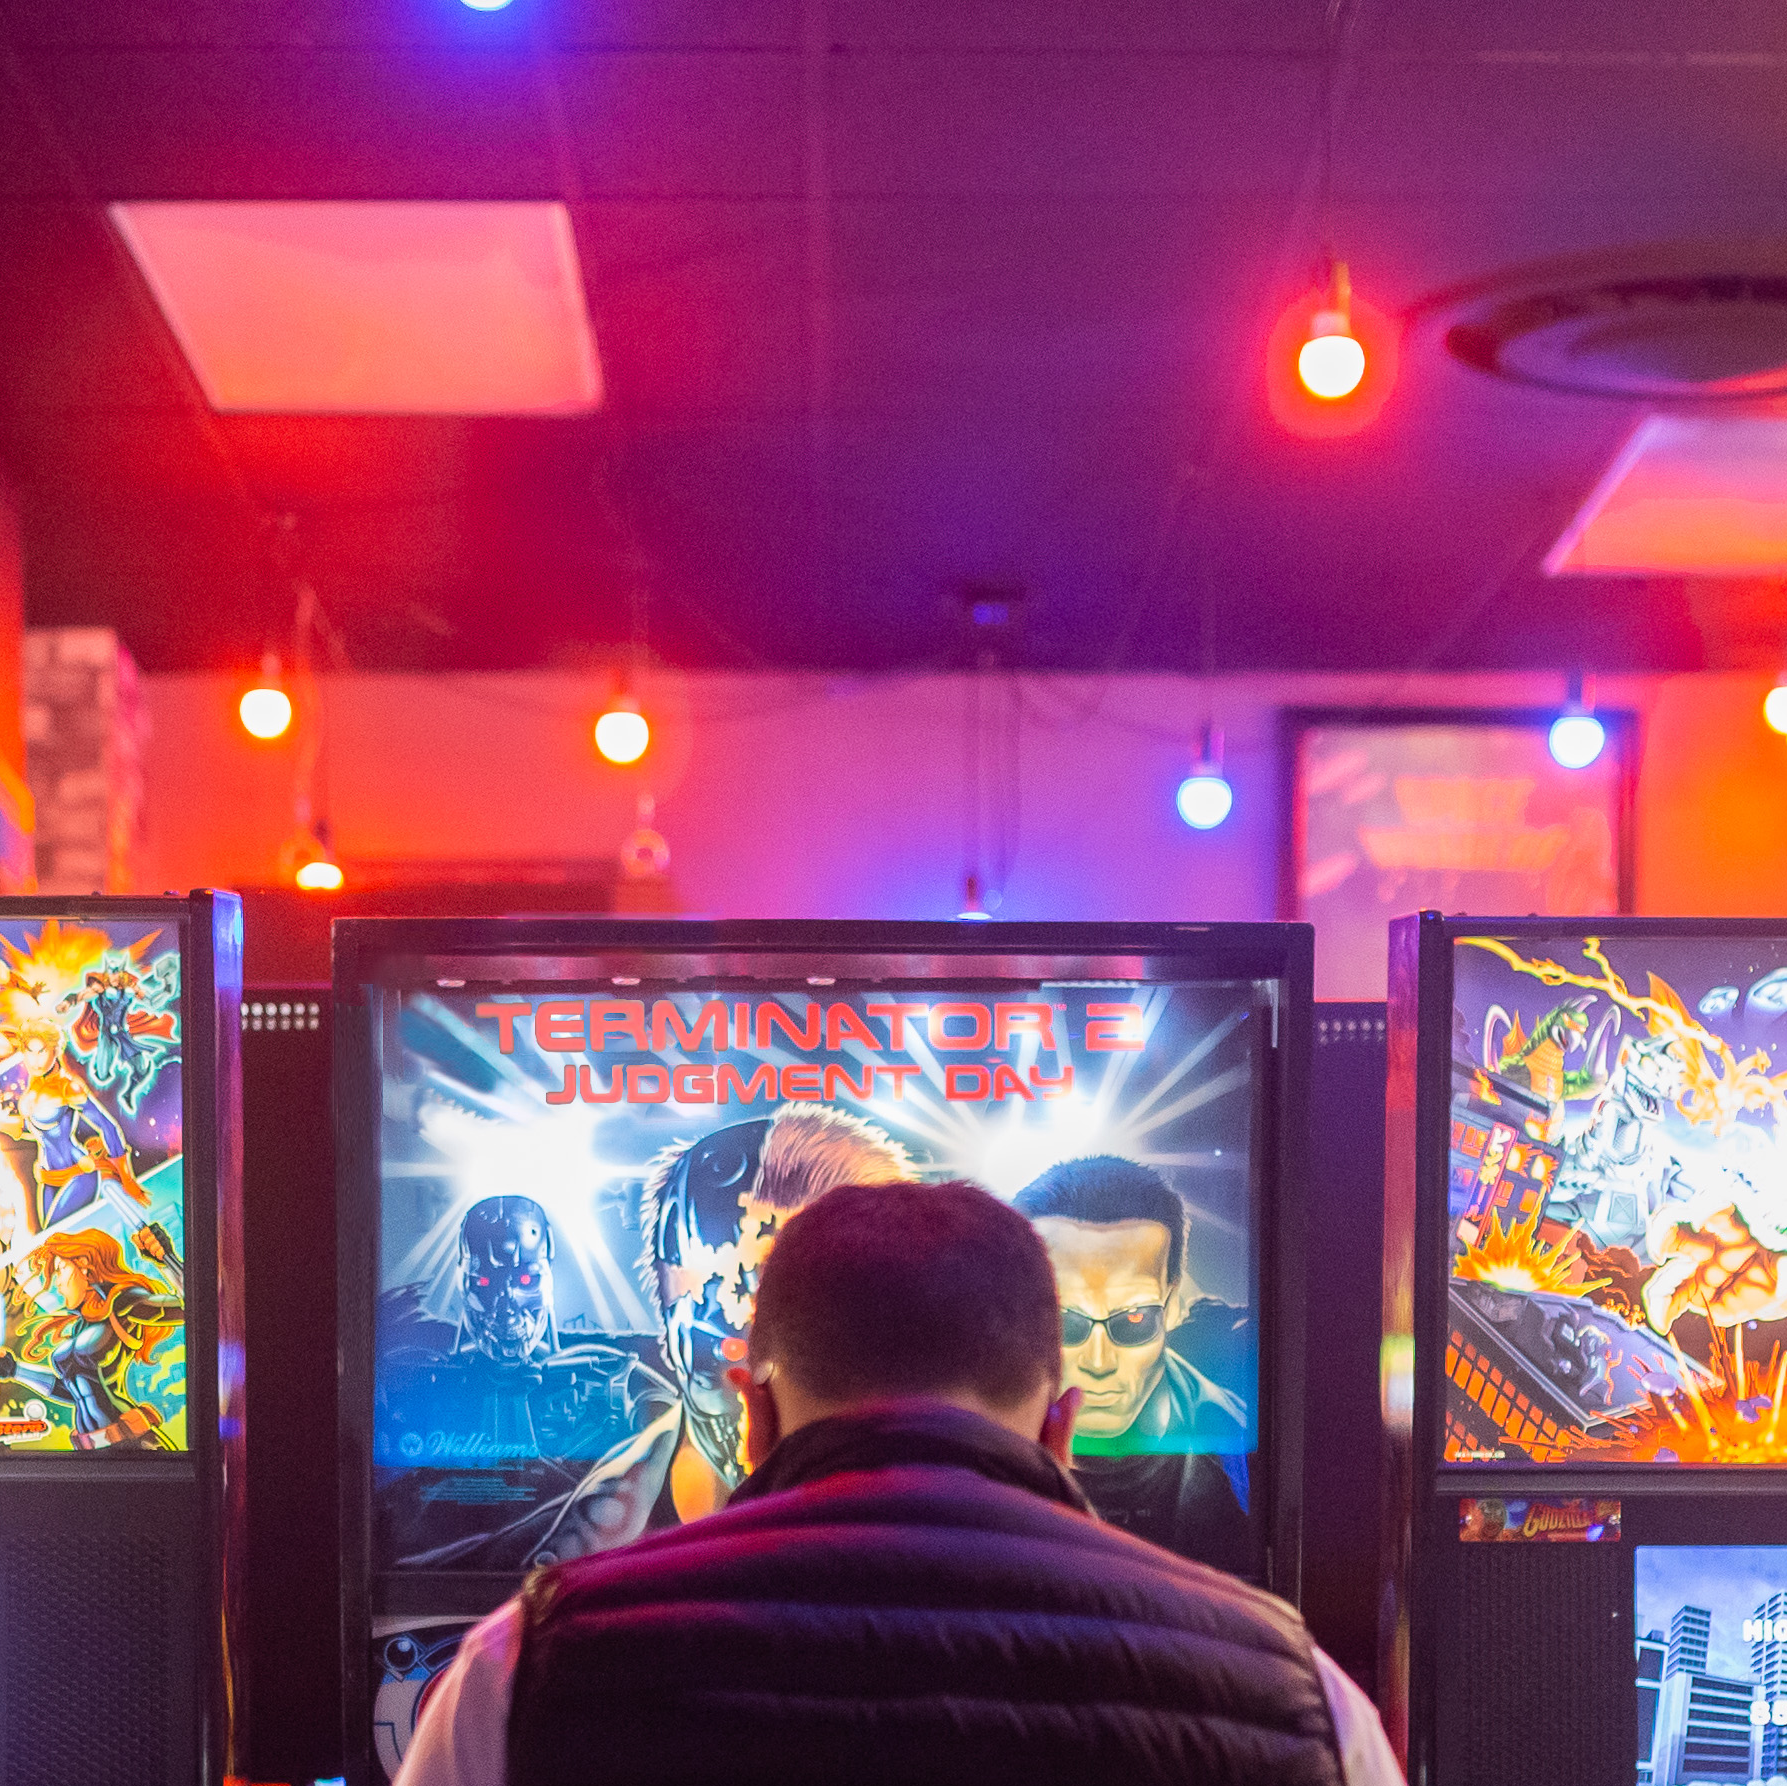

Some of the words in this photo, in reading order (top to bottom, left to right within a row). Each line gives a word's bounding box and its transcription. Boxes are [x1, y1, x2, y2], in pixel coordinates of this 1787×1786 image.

[474, 1000, 1056, 1055] TERMINATOR
[1085, 1002, 1146, 1053] 2
[545, 1064, 920, 1105] JUDGMENT
[945, 1064, 1075, 1104] DAY
[426, 1429, 540, 1458] Williams
